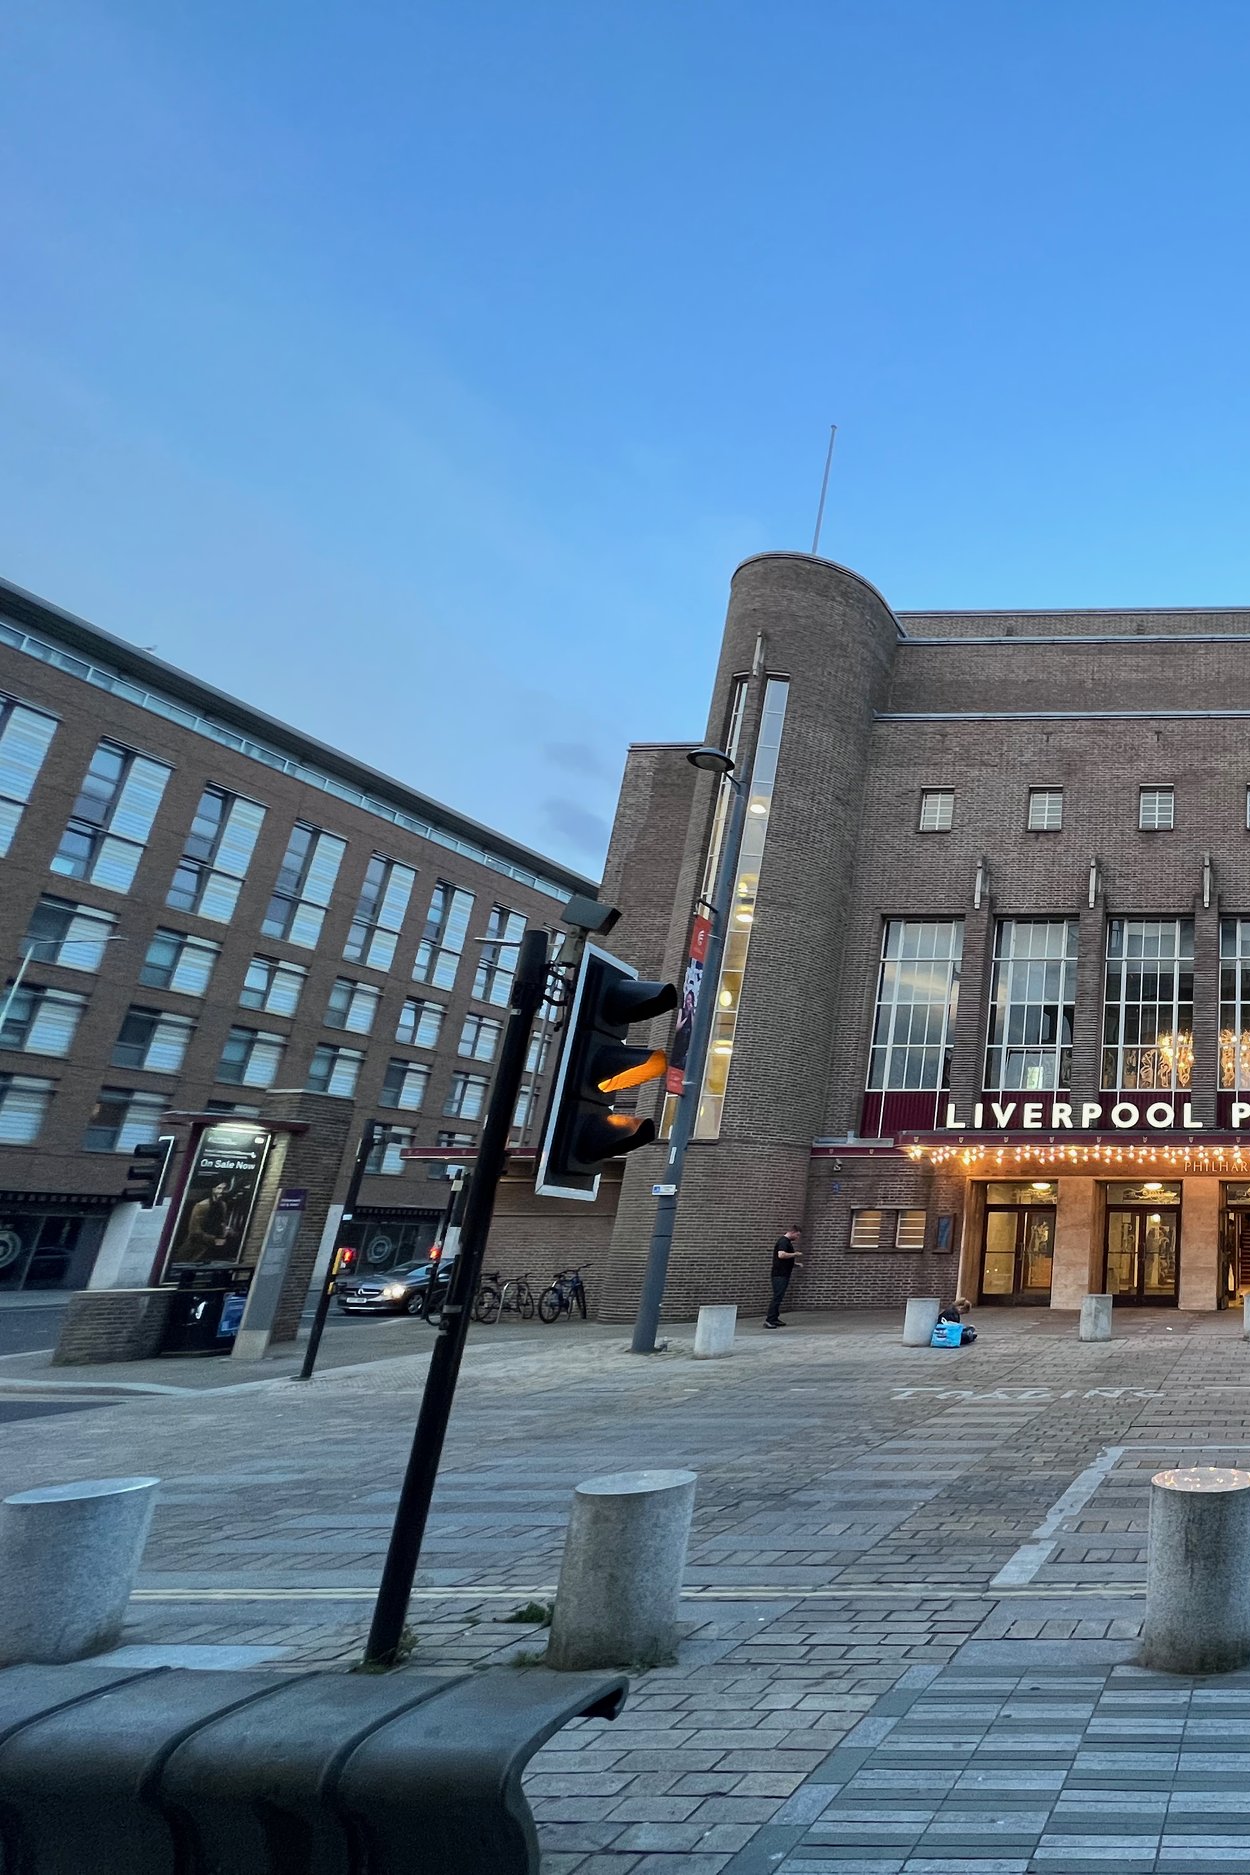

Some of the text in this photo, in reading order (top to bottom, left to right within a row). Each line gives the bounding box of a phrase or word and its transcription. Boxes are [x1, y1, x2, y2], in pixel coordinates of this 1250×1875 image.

[945, 1102, 1204, 1128] LIVERPOOL
[201, 1159, 255, 1169] On Sale Now
[889, 1388, 1167, 1400] LOADING
